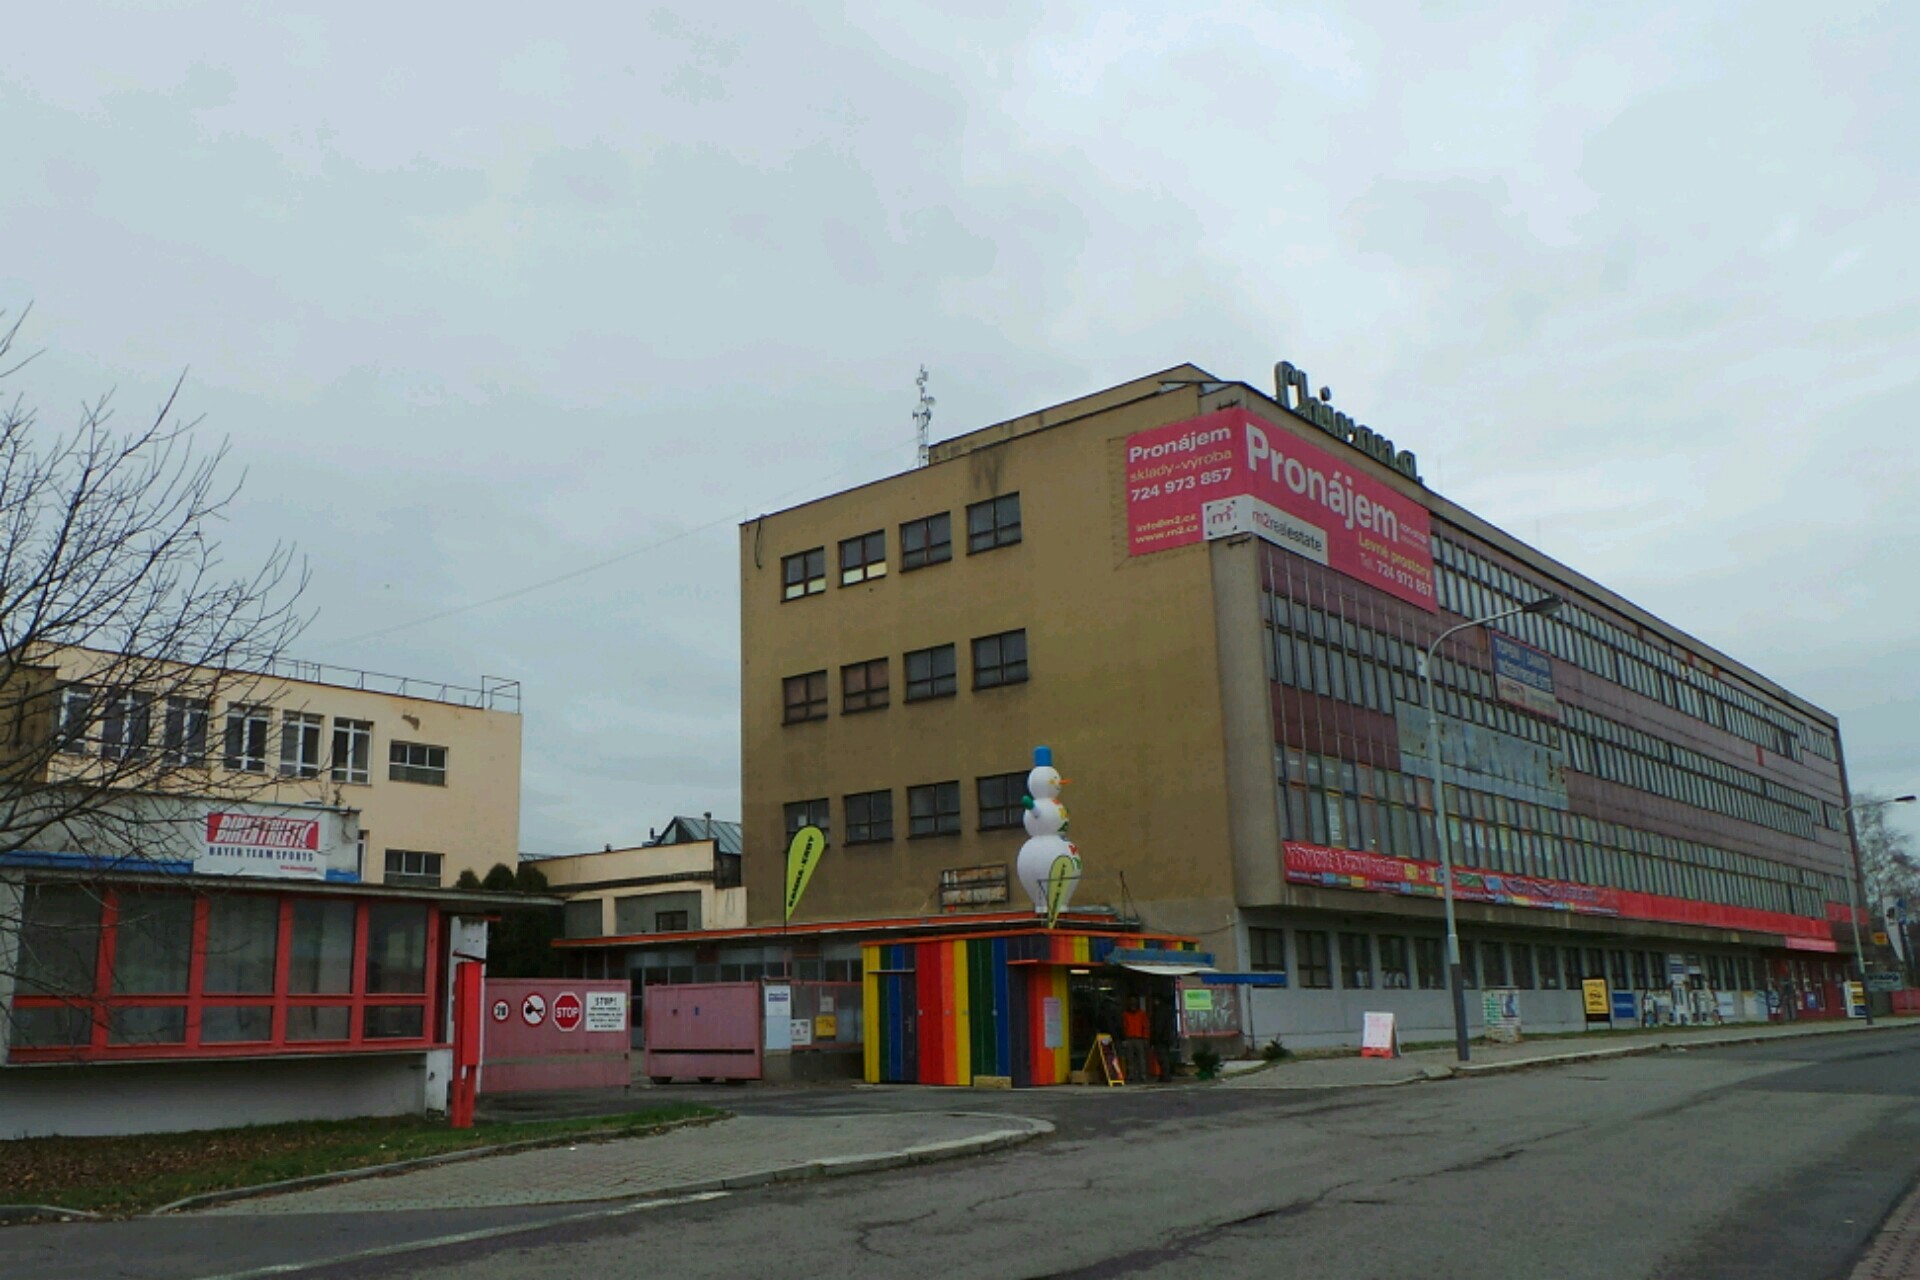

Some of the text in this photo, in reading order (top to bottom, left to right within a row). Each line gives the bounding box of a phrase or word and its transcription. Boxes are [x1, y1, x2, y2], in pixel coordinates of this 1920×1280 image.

[1129, 427, 1231, 463] Pronájem
[1131, 467, 1232, 502] 724 973 857
[1246, 422, 1398, 543] Pronájem
[246, 849, 273, 859] TEAM
[276, 850, 313, 862] SPORTS
[556, 1007, 579, 1018] STOP
